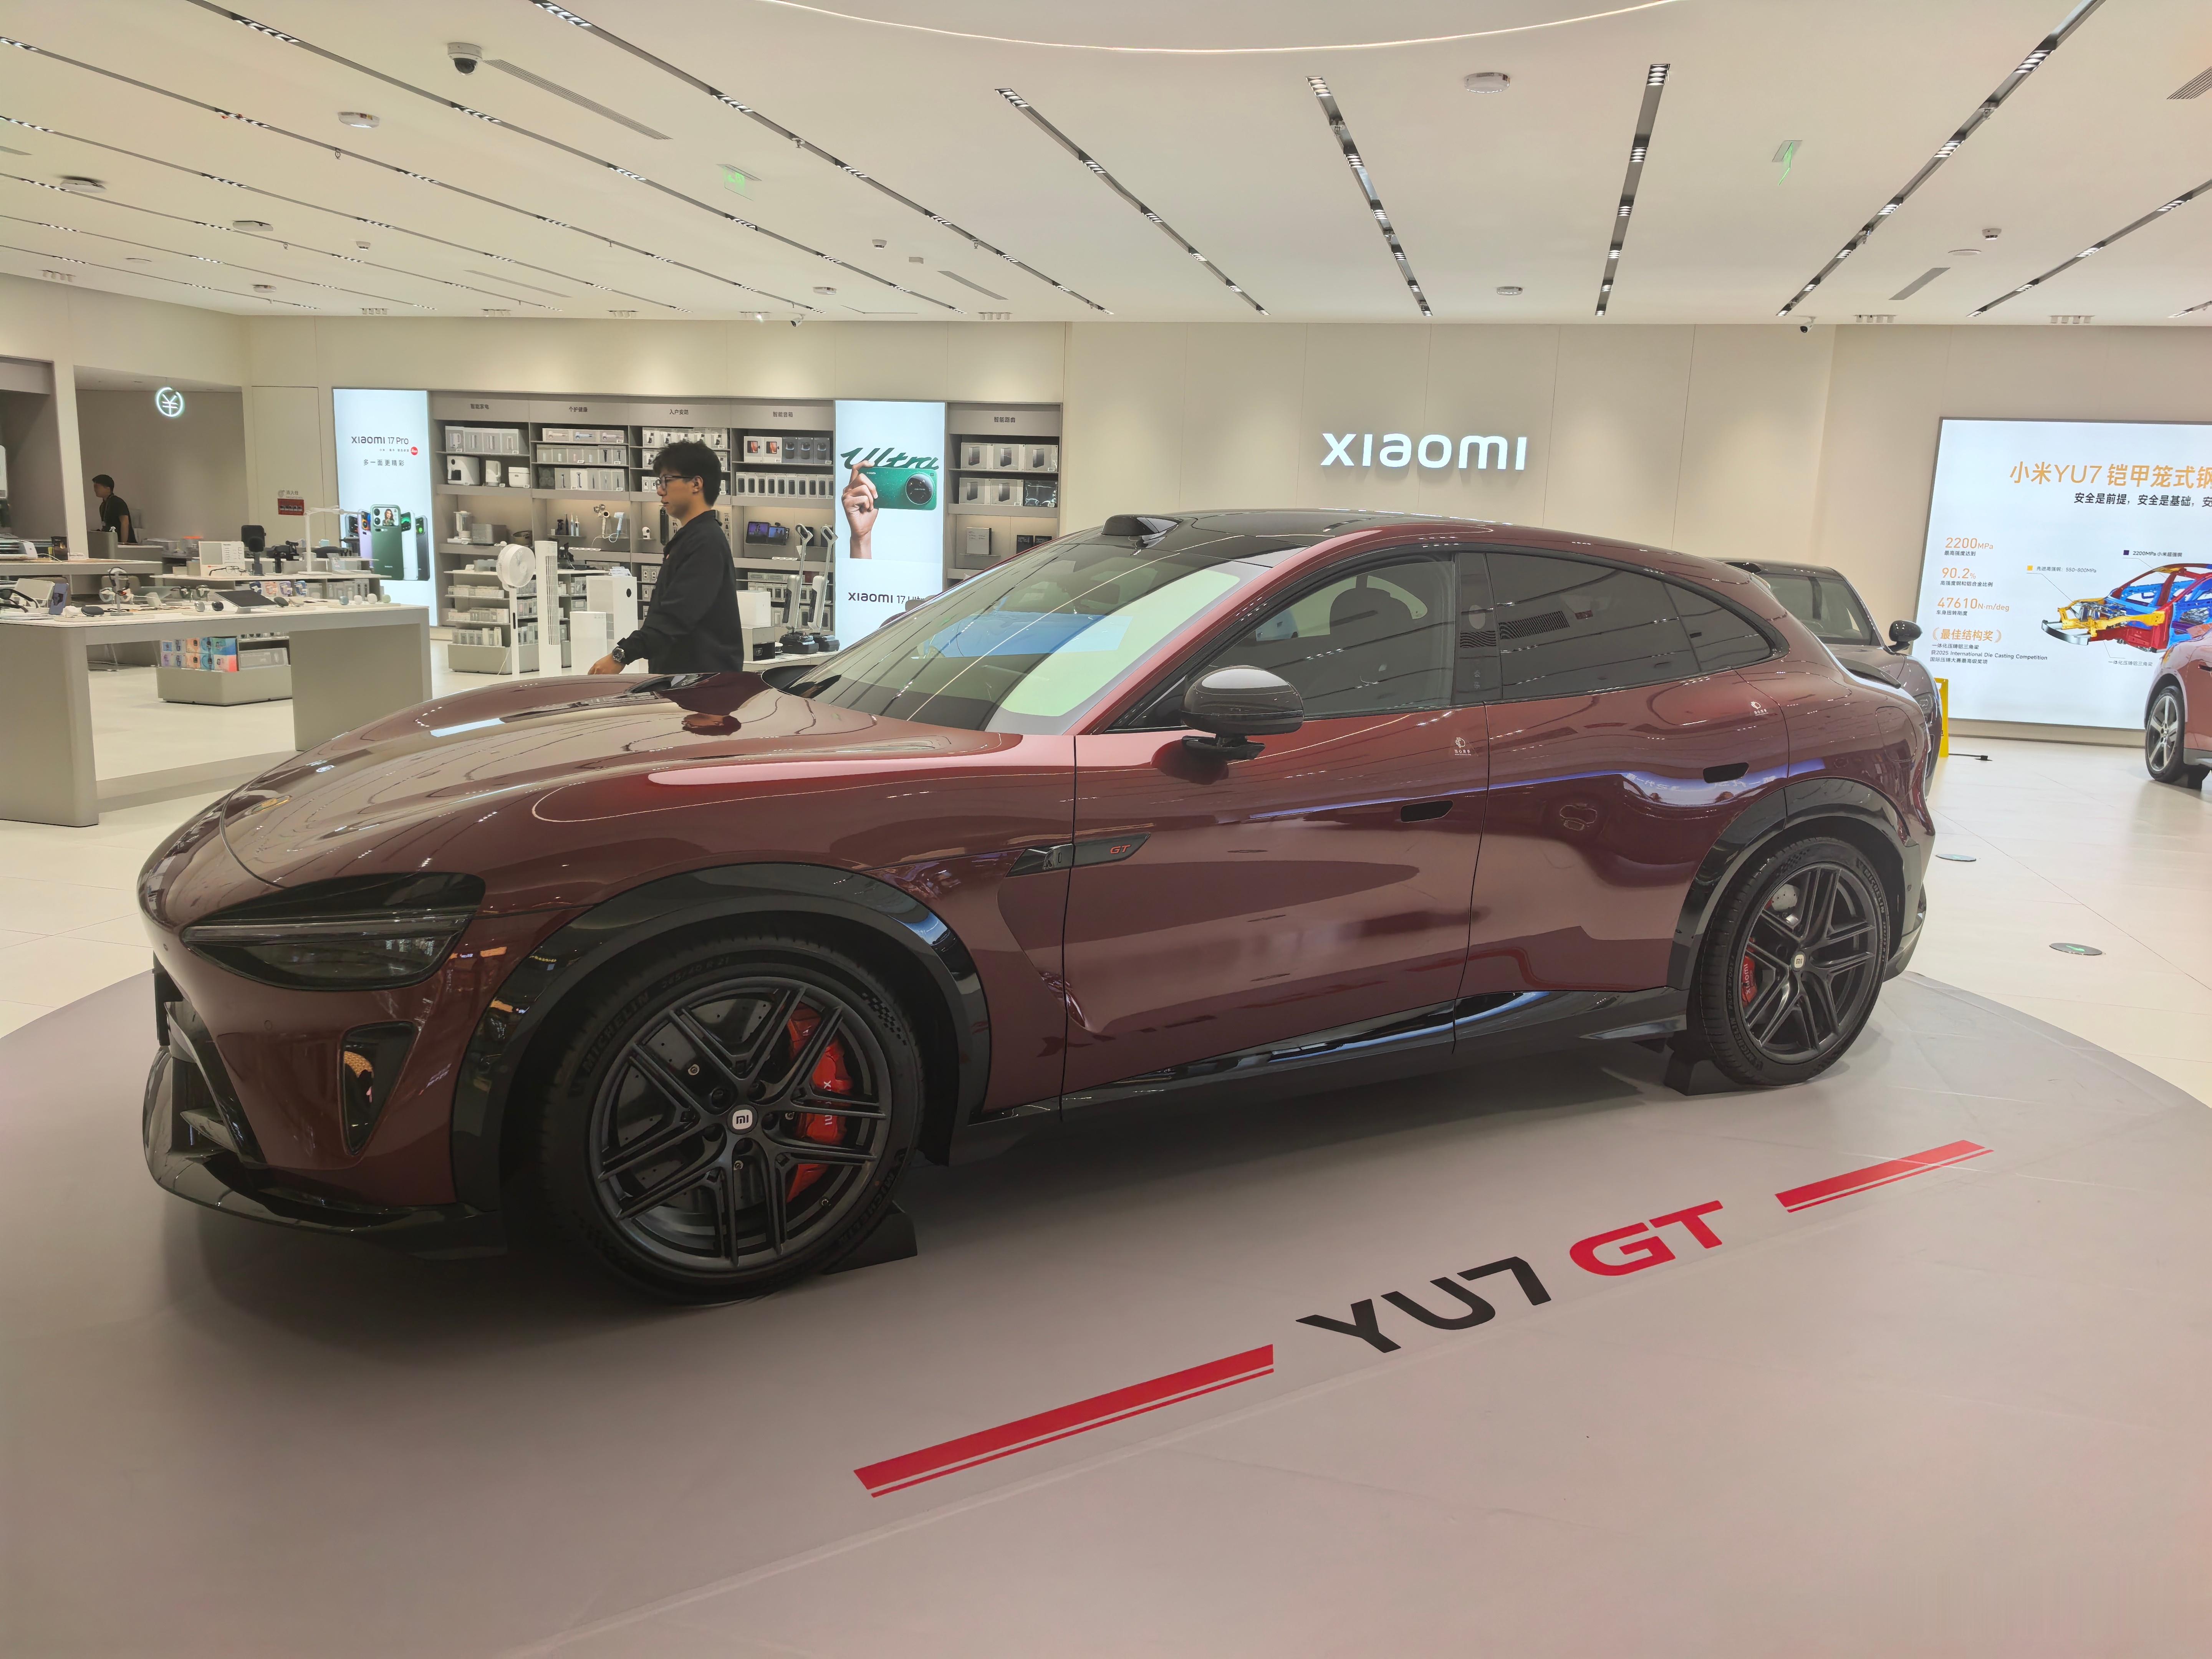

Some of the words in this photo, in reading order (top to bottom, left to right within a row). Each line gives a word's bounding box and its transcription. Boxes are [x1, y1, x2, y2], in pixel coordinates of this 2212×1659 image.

[840, 447, 939, 470] Ultra
[1320, 433, 1527, 470] xiaomi
[2010, 461, 2102, 485] 小米YU7
[1942, 568, 1976, 579] 90.2%
[848, 592, 893, 603] xiaomi
[897, 595, 906, 604] 17
[1940, 629, 1993, 641] 最佳结构奖
[1110, 845, 1131, 854] GT
[582, 992, 649, 1073] MICHELIN
[1295, 1256, 1552, 1353] YU7
[1569, 1200, 1724, 1277] GT
